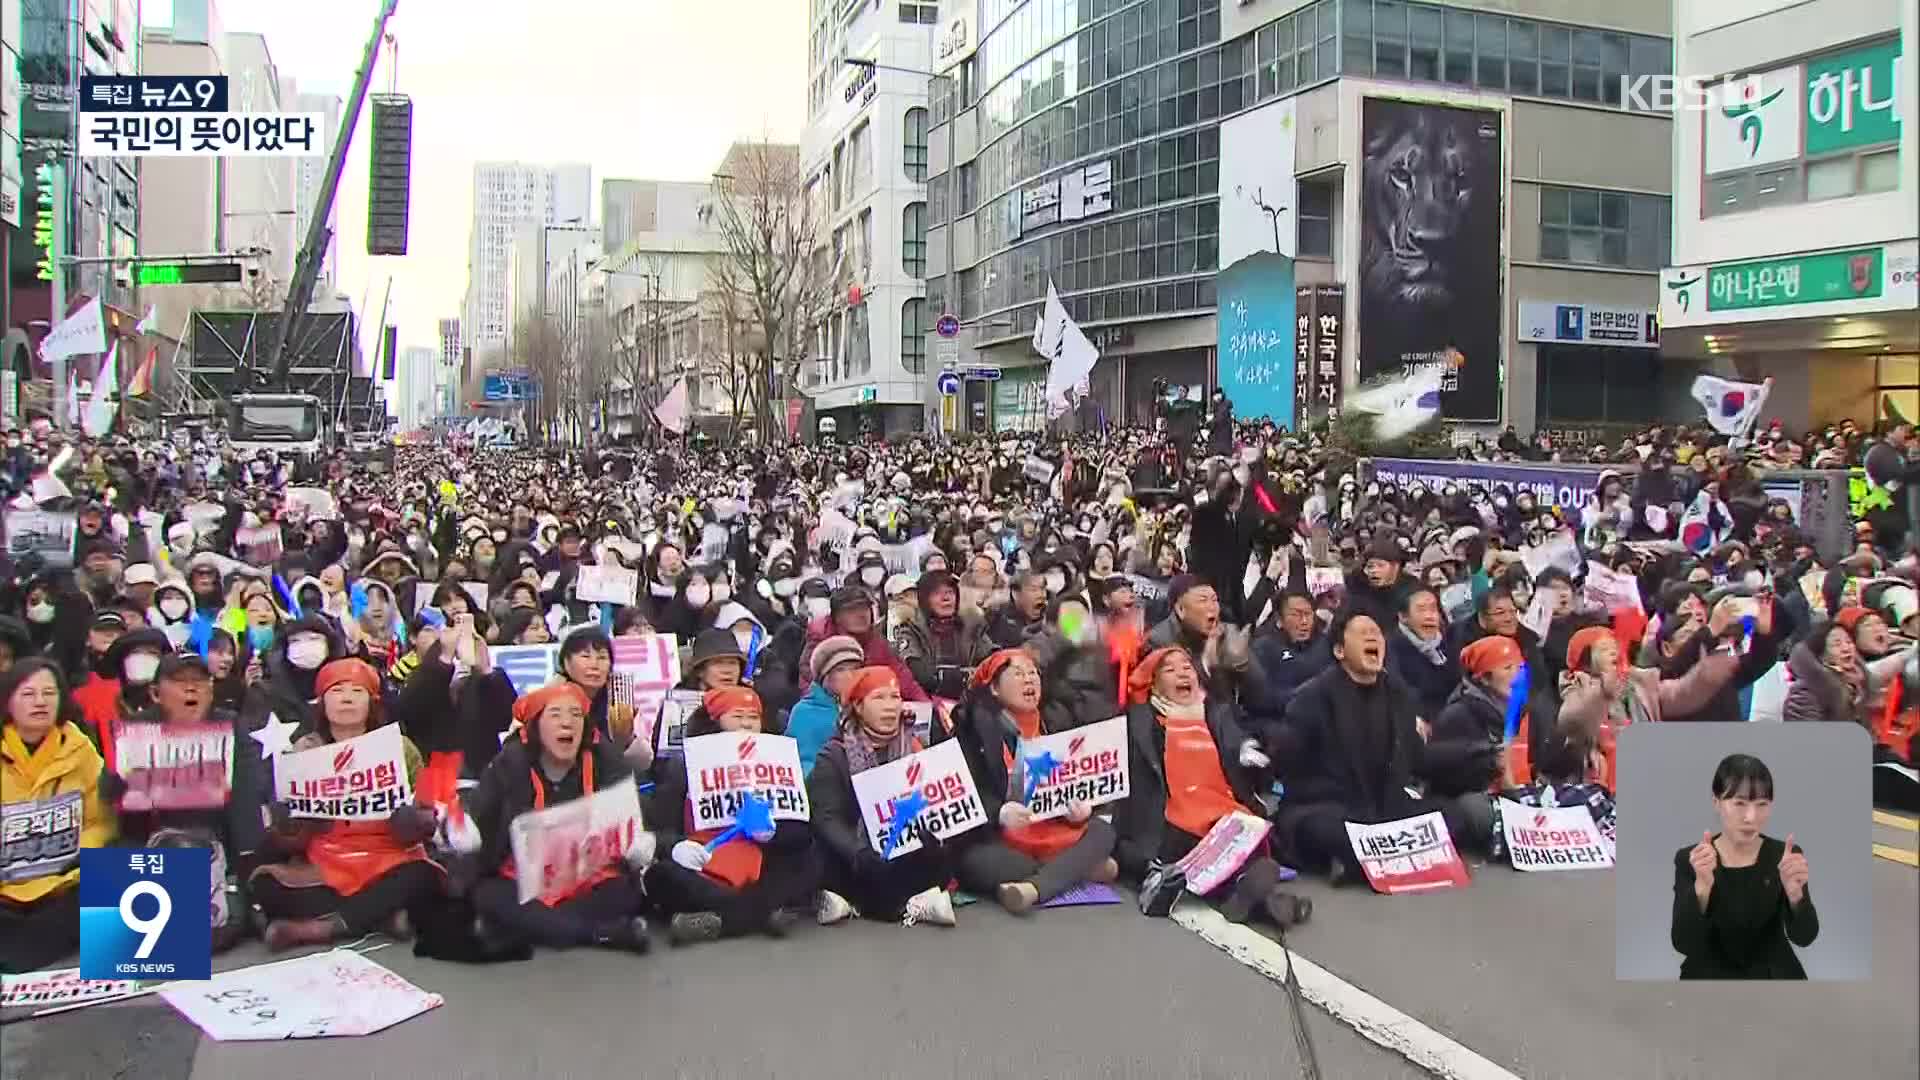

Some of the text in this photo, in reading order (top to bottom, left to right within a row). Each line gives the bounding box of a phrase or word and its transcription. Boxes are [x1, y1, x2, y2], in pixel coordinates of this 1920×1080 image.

[1711, 264, 1800, 303] 하나은행
[1590, 312, 1639, 328] 법무법인
[289, 760, 397, 798] 내란의힘
[701, 764, 796, 792] 내란의힘
[875, 772, 966, 824] 내의힘
[1359, 820, 1439, 856] 내란수괴
[1512, 826, 1592, 847] 내란의힘
